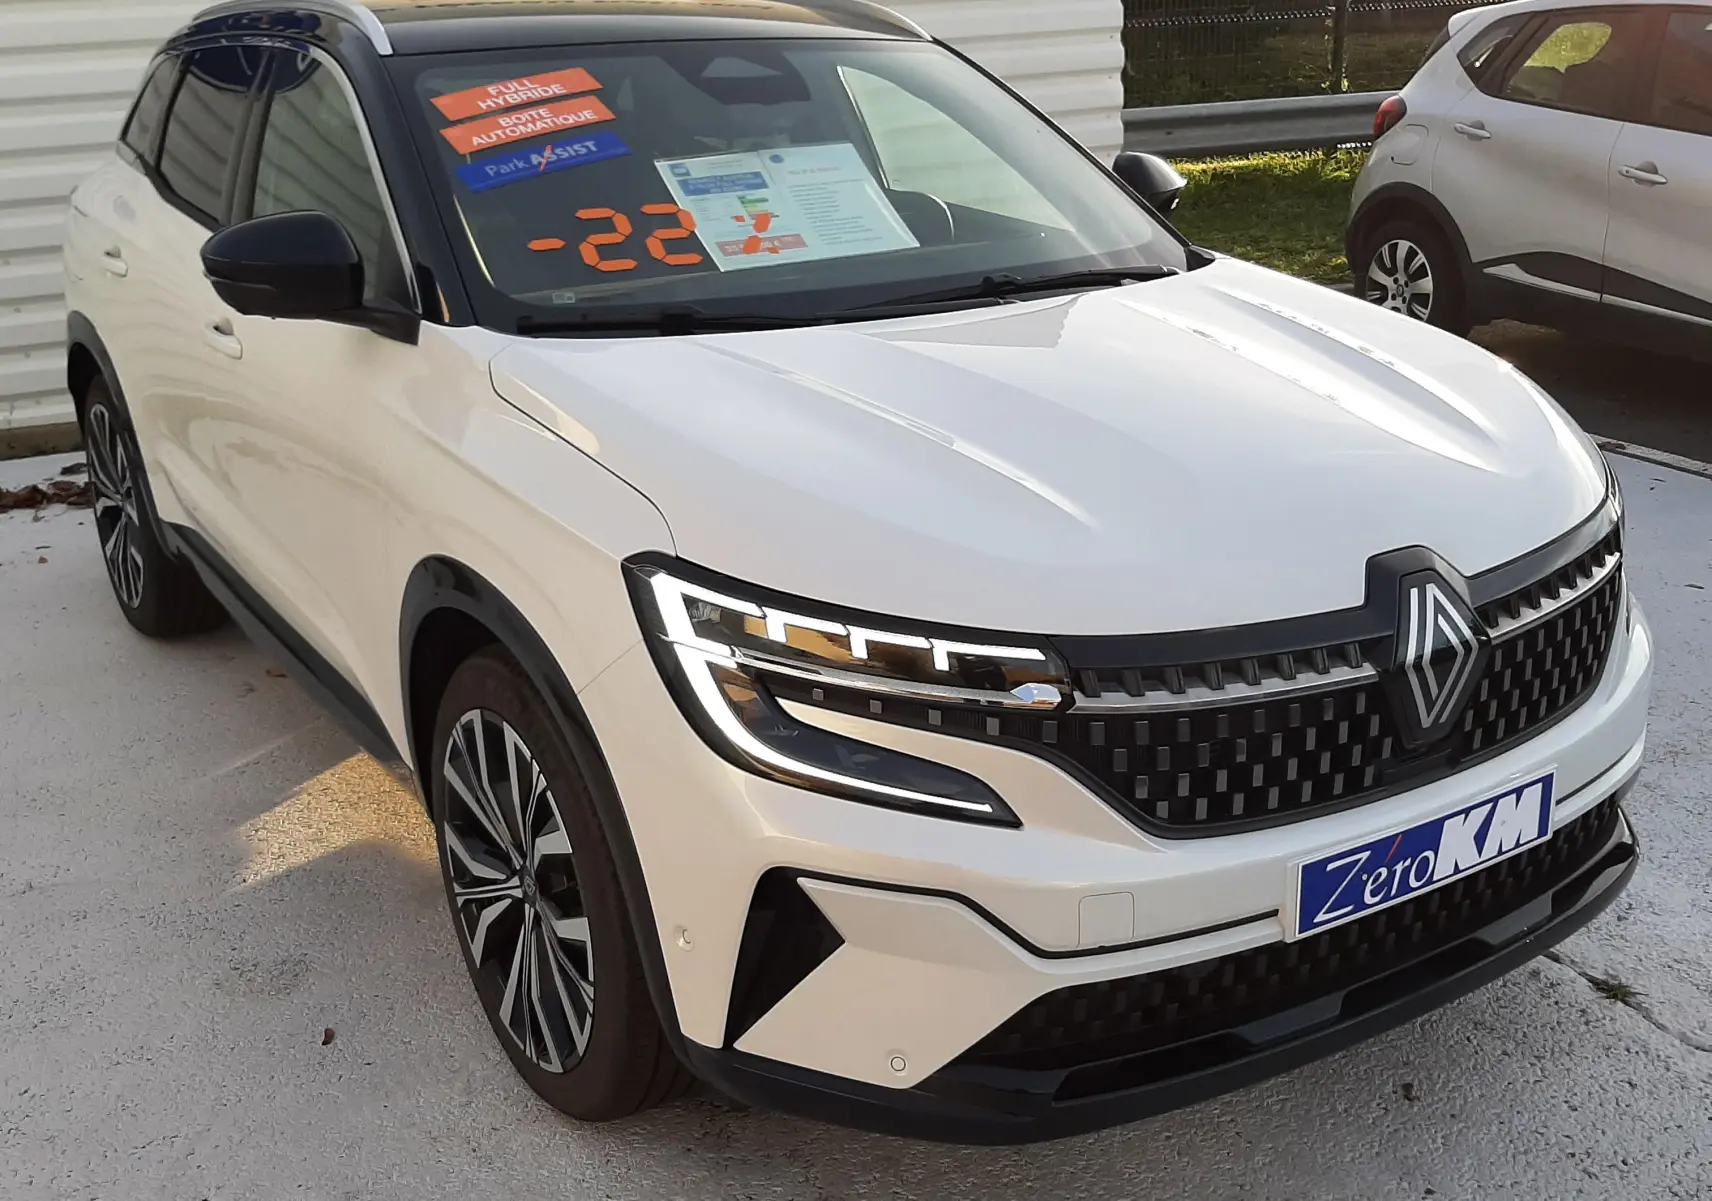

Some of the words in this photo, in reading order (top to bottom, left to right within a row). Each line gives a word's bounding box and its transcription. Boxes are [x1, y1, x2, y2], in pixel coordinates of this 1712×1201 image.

[477, 83, 567, 110] HYBRIDE
[487, 79, 541, 96] FULL
[472, 109, 598, 146] AUTOMATIQUE
[498, 108, 554, 128] BOITE
[484, 158, 530, 176] Park
[530, 141, 598, 166] ASSIST
